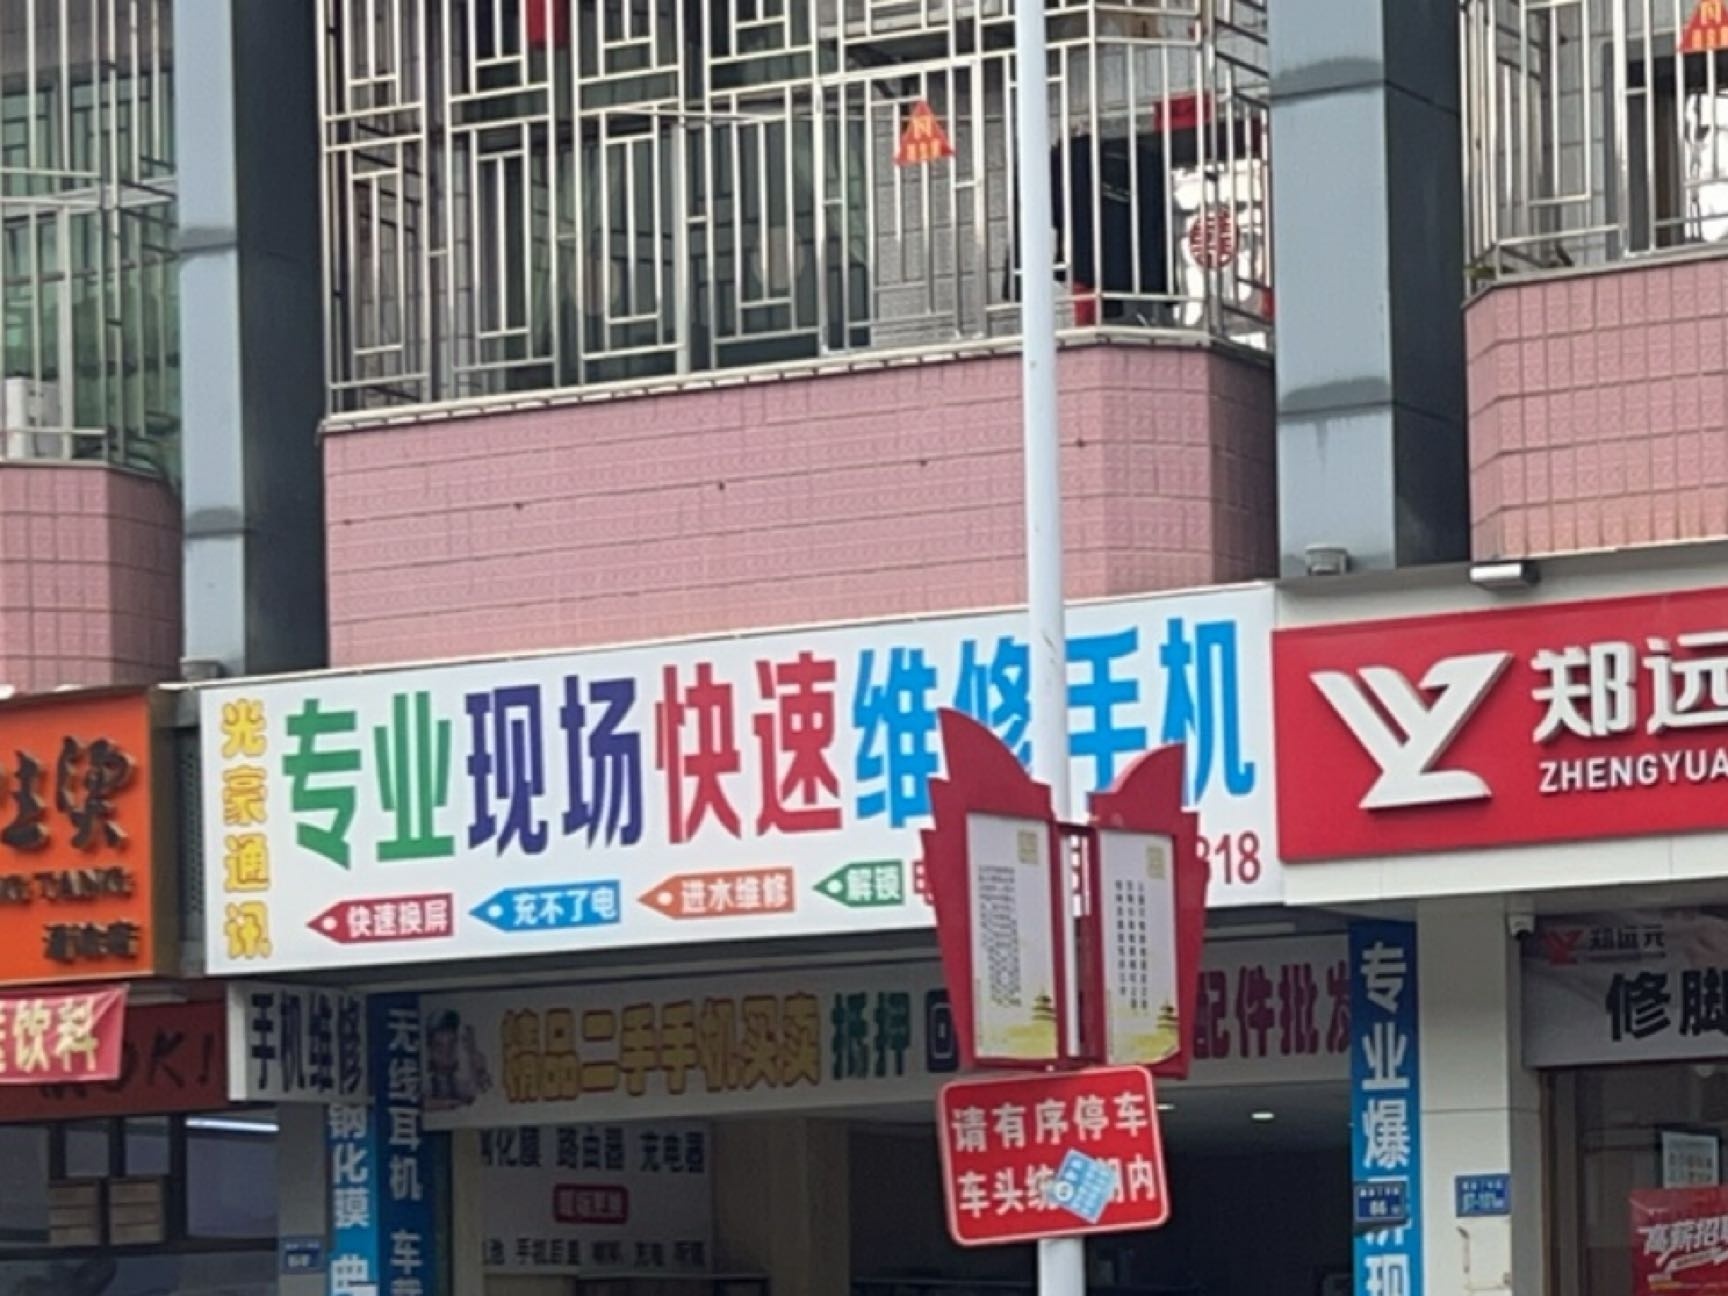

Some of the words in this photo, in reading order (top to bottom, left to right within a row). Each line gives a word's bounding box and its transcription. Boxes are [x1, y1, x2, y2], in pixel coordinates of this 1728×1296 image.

[680, 872, 788, 915] 进水维修
[846, 865, 903, 903] 解锁
[346, 902, 449, 938] 快速换屏
[511, 887, 620, 926] 充不了电
[0, 997, 98, 1073] 饮料
[951, 1091, 1147, 1153] 请有序停车
